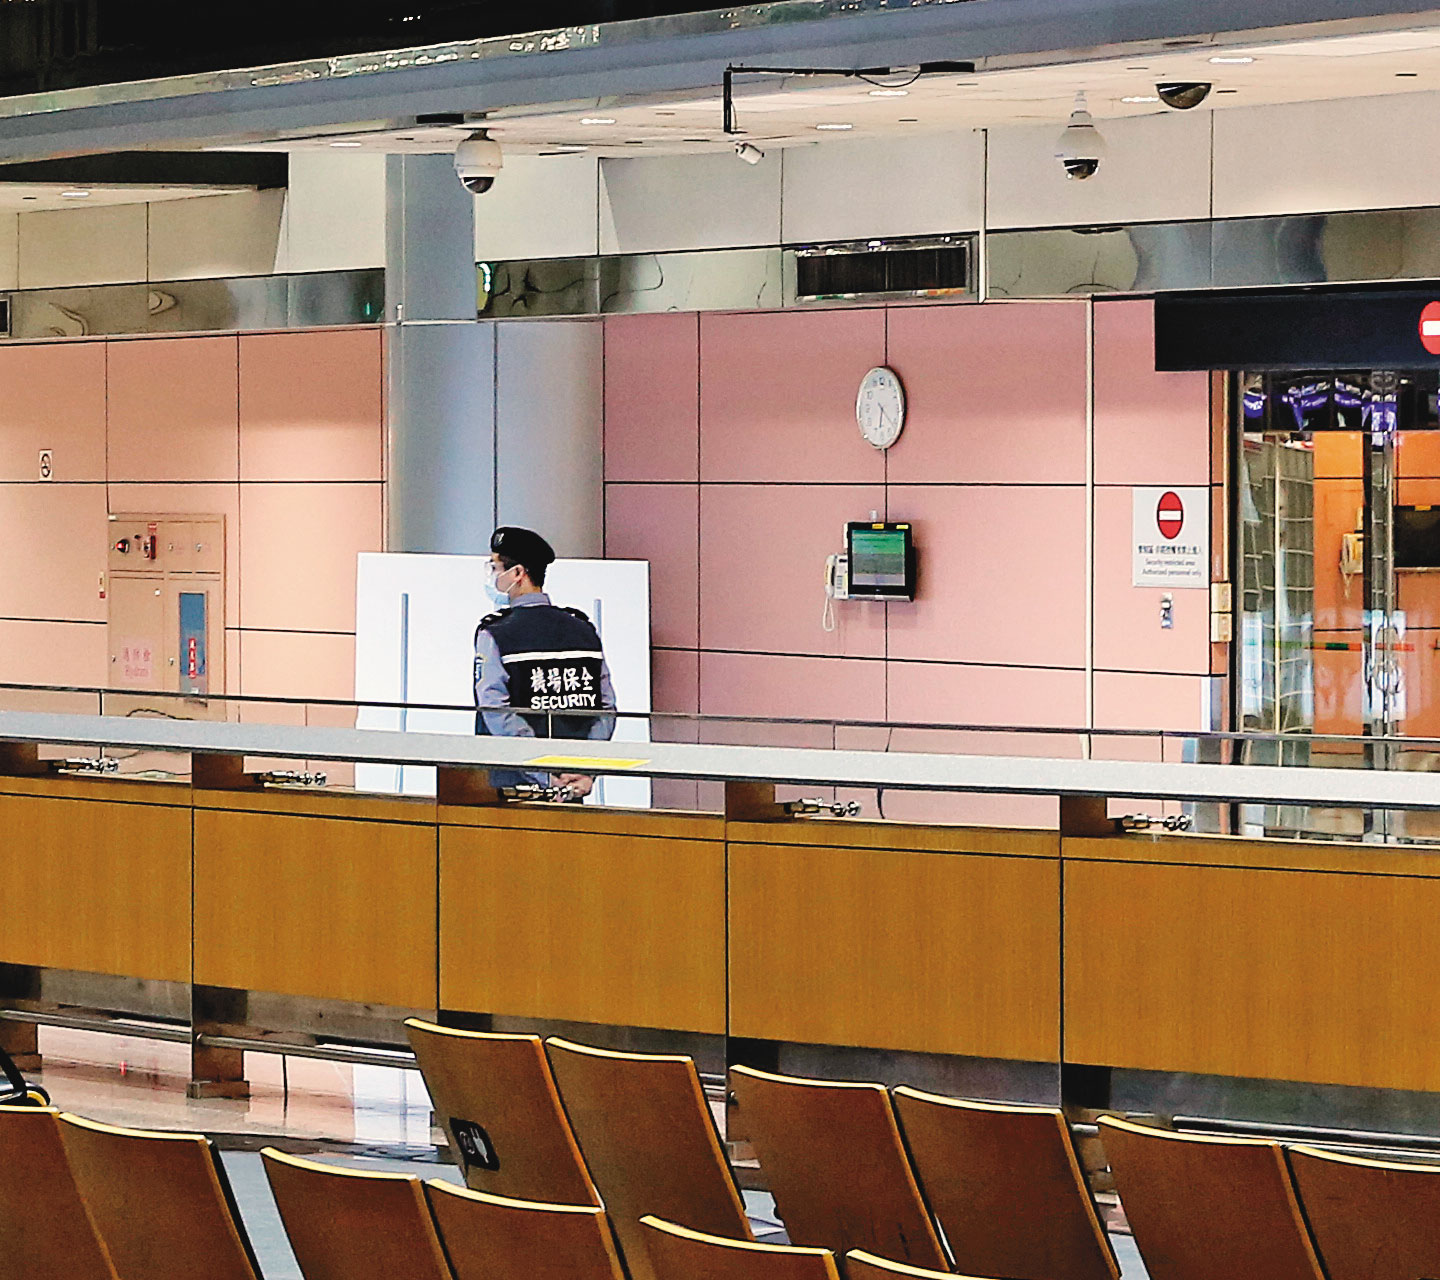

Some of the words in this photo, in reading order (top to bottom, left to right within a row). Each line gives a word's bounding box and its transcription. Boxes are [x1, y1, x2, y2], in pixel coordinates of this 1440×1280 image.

[530, 666, 593, 693] 機場保全
[530, 694, 597, 710] SECURITY
